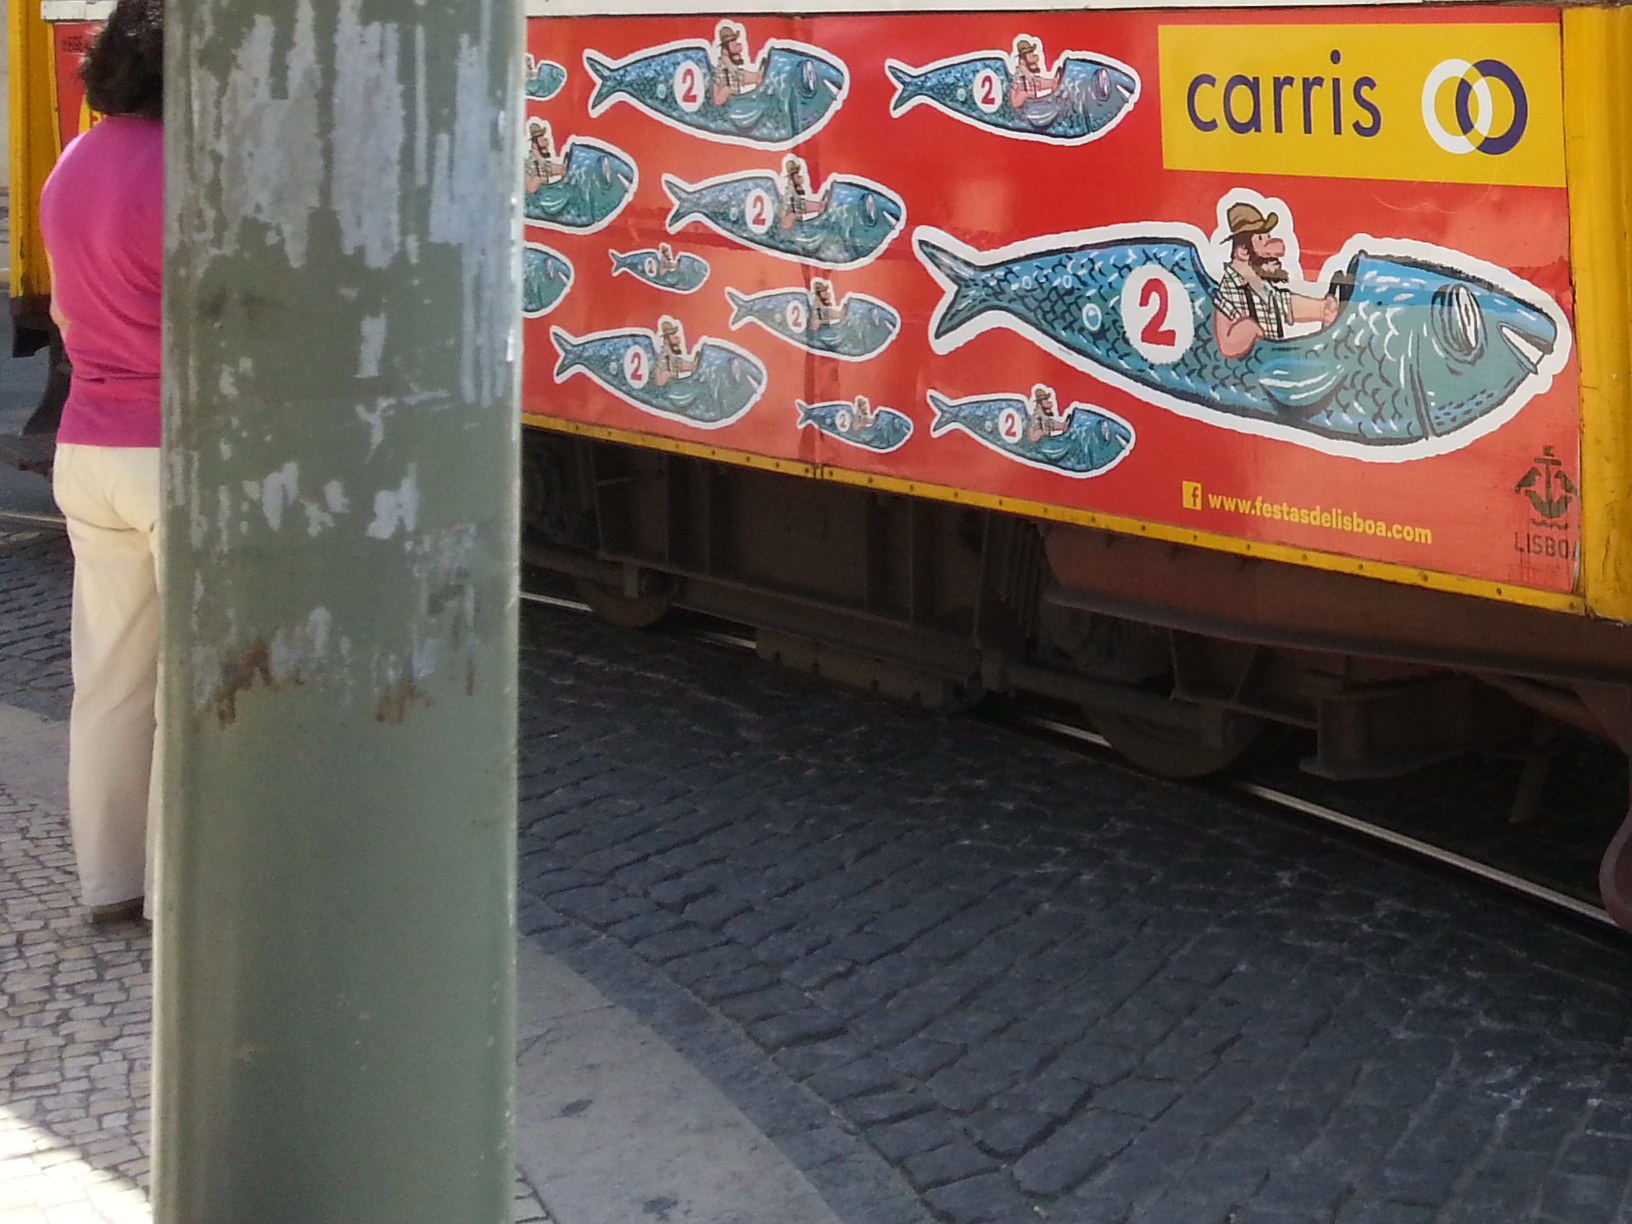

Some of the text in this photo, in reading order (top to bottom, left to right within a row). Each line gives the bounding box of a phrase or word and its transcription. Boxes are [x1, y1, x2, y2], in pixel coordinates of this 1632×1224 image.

[682, 68, 699, 104] 2
[981, 75, 997, 106] 2
[1186, 48, 1383, 138] carris
[752, 194, 767, 227] 2
[791, 304, 803, 329] 2
[1138, 277, 1177, 347] 2
[630, 351, 643, 382] 2
[839, 412, 848, 429] 2
[1004, 412, 1017, 438] 2
[1208, 495, 1432, 545] www.festasdelisboa.com
